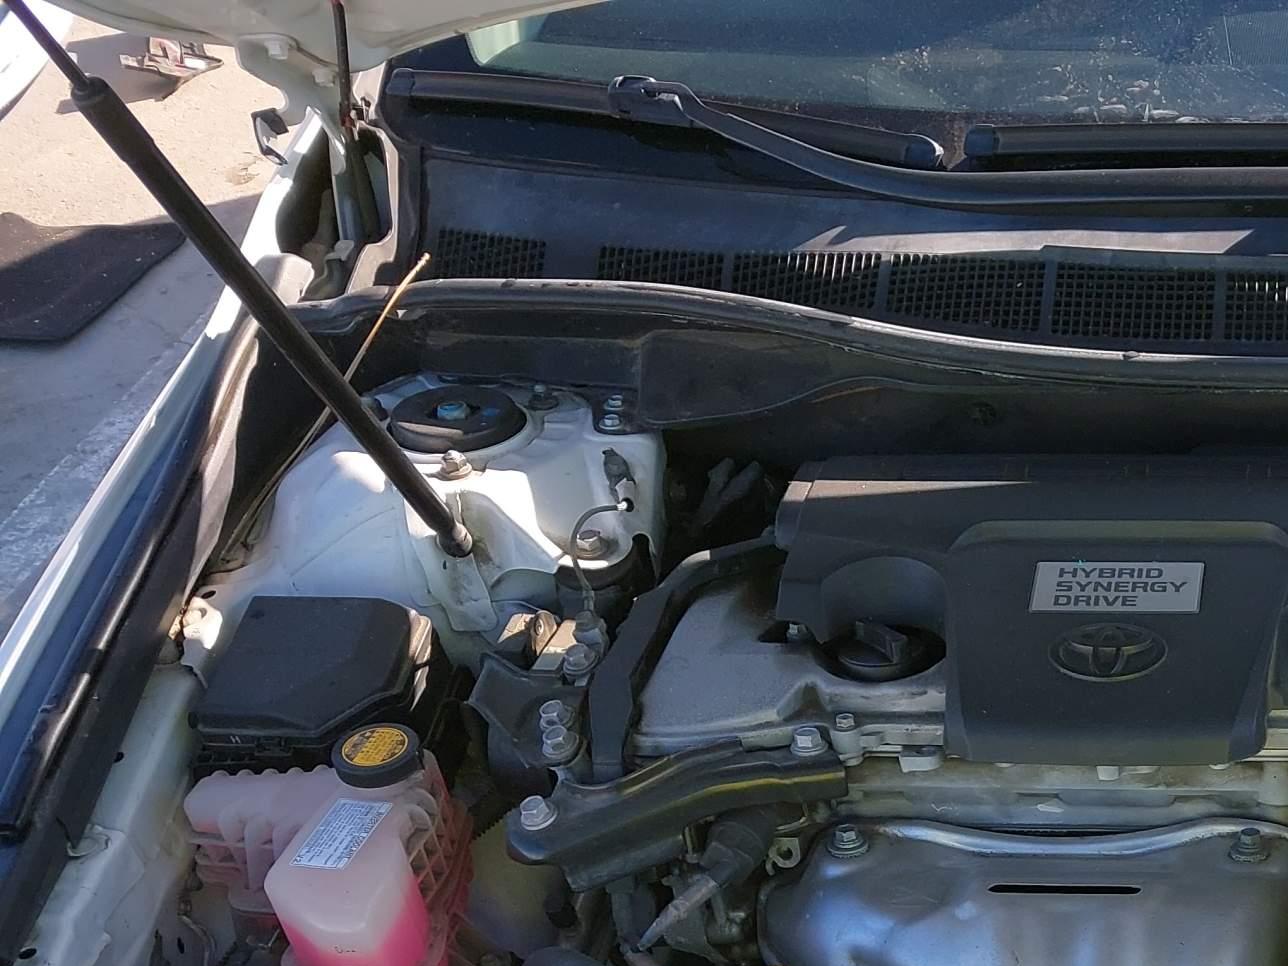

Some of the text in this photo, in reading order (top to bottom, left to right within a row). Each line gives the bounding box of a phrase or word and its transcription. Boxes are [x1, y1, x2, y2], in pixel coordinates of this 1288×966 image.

[1058, 567, 1163, 579] HYBRID
[1055, 581, 1187, 593] SYNERGY
[1053, 595, 1138, 607] DRIVE
